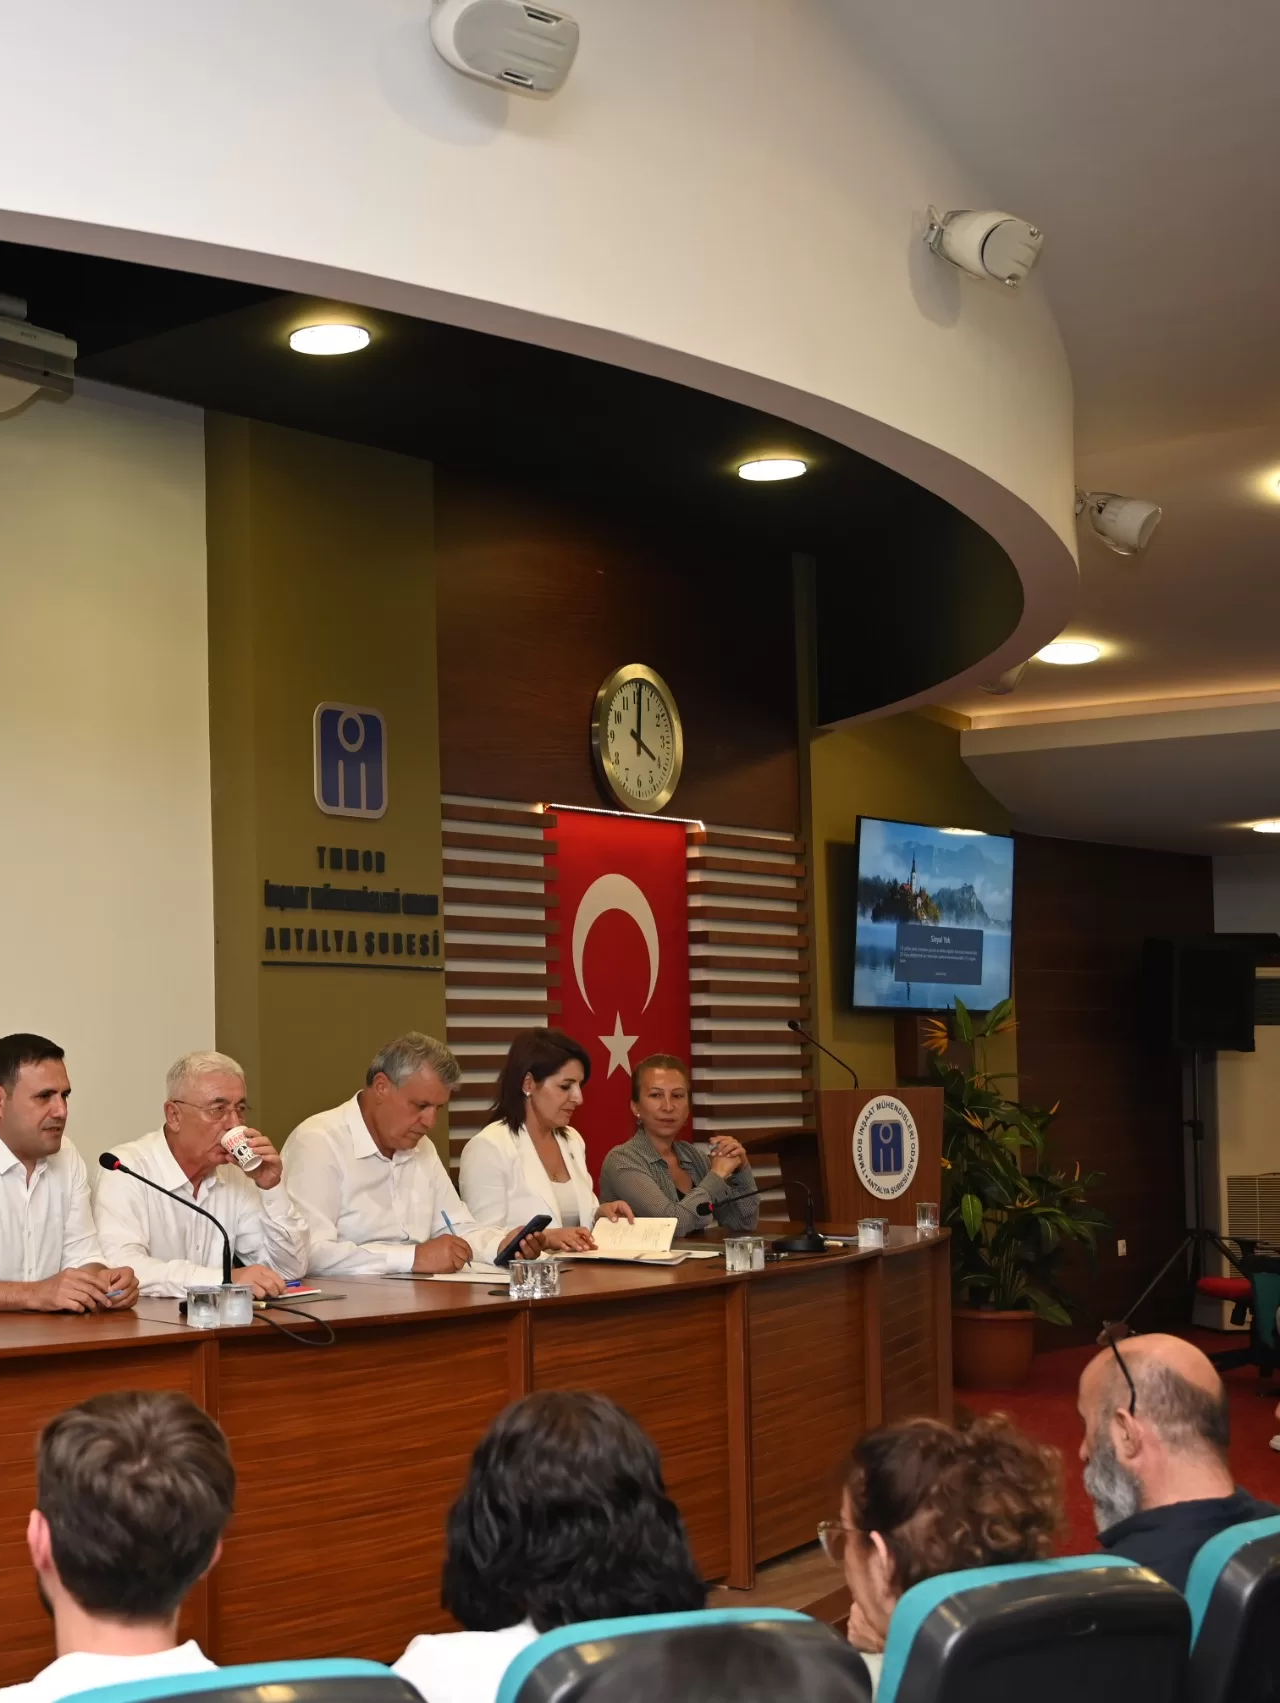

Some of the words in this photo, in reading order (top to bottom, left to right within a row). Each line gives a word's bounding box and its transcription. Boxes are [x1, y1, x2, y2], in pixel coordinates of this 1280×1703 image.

[622, 697, 629, 711] 11
[614, 710, 622, 724] 10
[655, 713, 661, 727] 2
[609, 731, 615, 743] 9
[660, 735, 665, 749] 3
[614, 752, 620, 765] 8
[625, 768, 629, 781] 7
[636, 775, 642, 788] 6
[648, 770, 654, 784] 5
[856, 1138, 867, 1175] TMMOB
[906, 1142, 916, 1174] ODASI
[866, 1178, 890, 1194] ANTALYA
